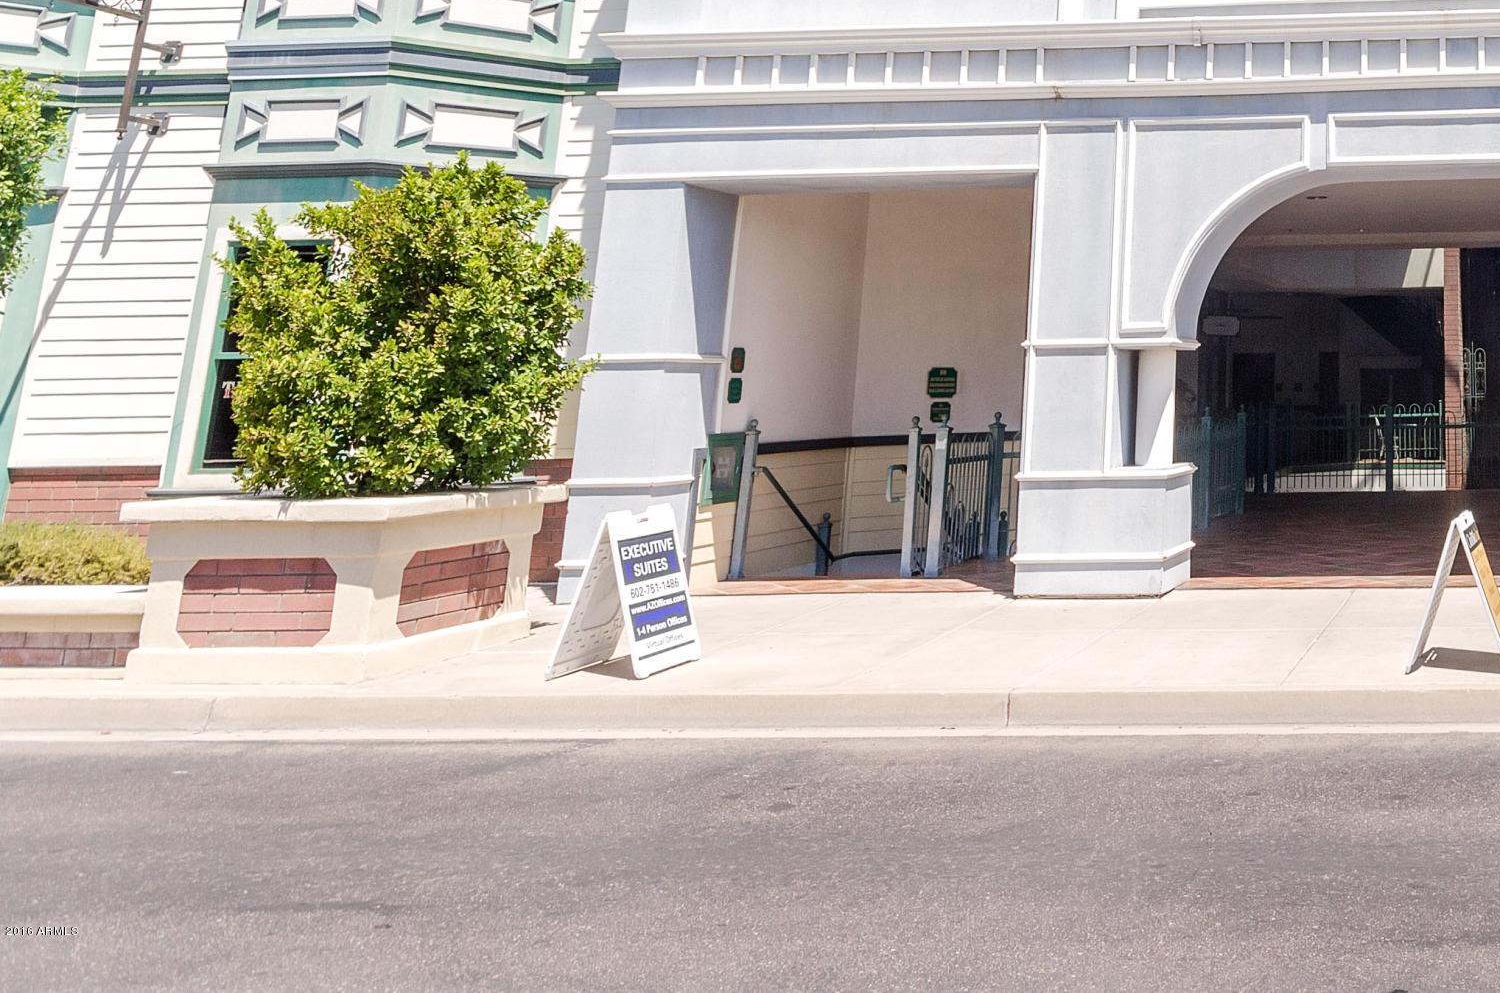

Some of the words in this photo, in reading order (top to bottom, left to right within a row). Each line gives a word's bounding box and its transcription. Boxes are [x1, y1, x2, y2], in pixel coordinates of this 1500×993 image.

[620, 537, 675, 560] EXECUTIVE
[633, 557, 669, 577] SUITES
[646, 621, 668, 634] Person
[666, 615, 688, 628] Offices
